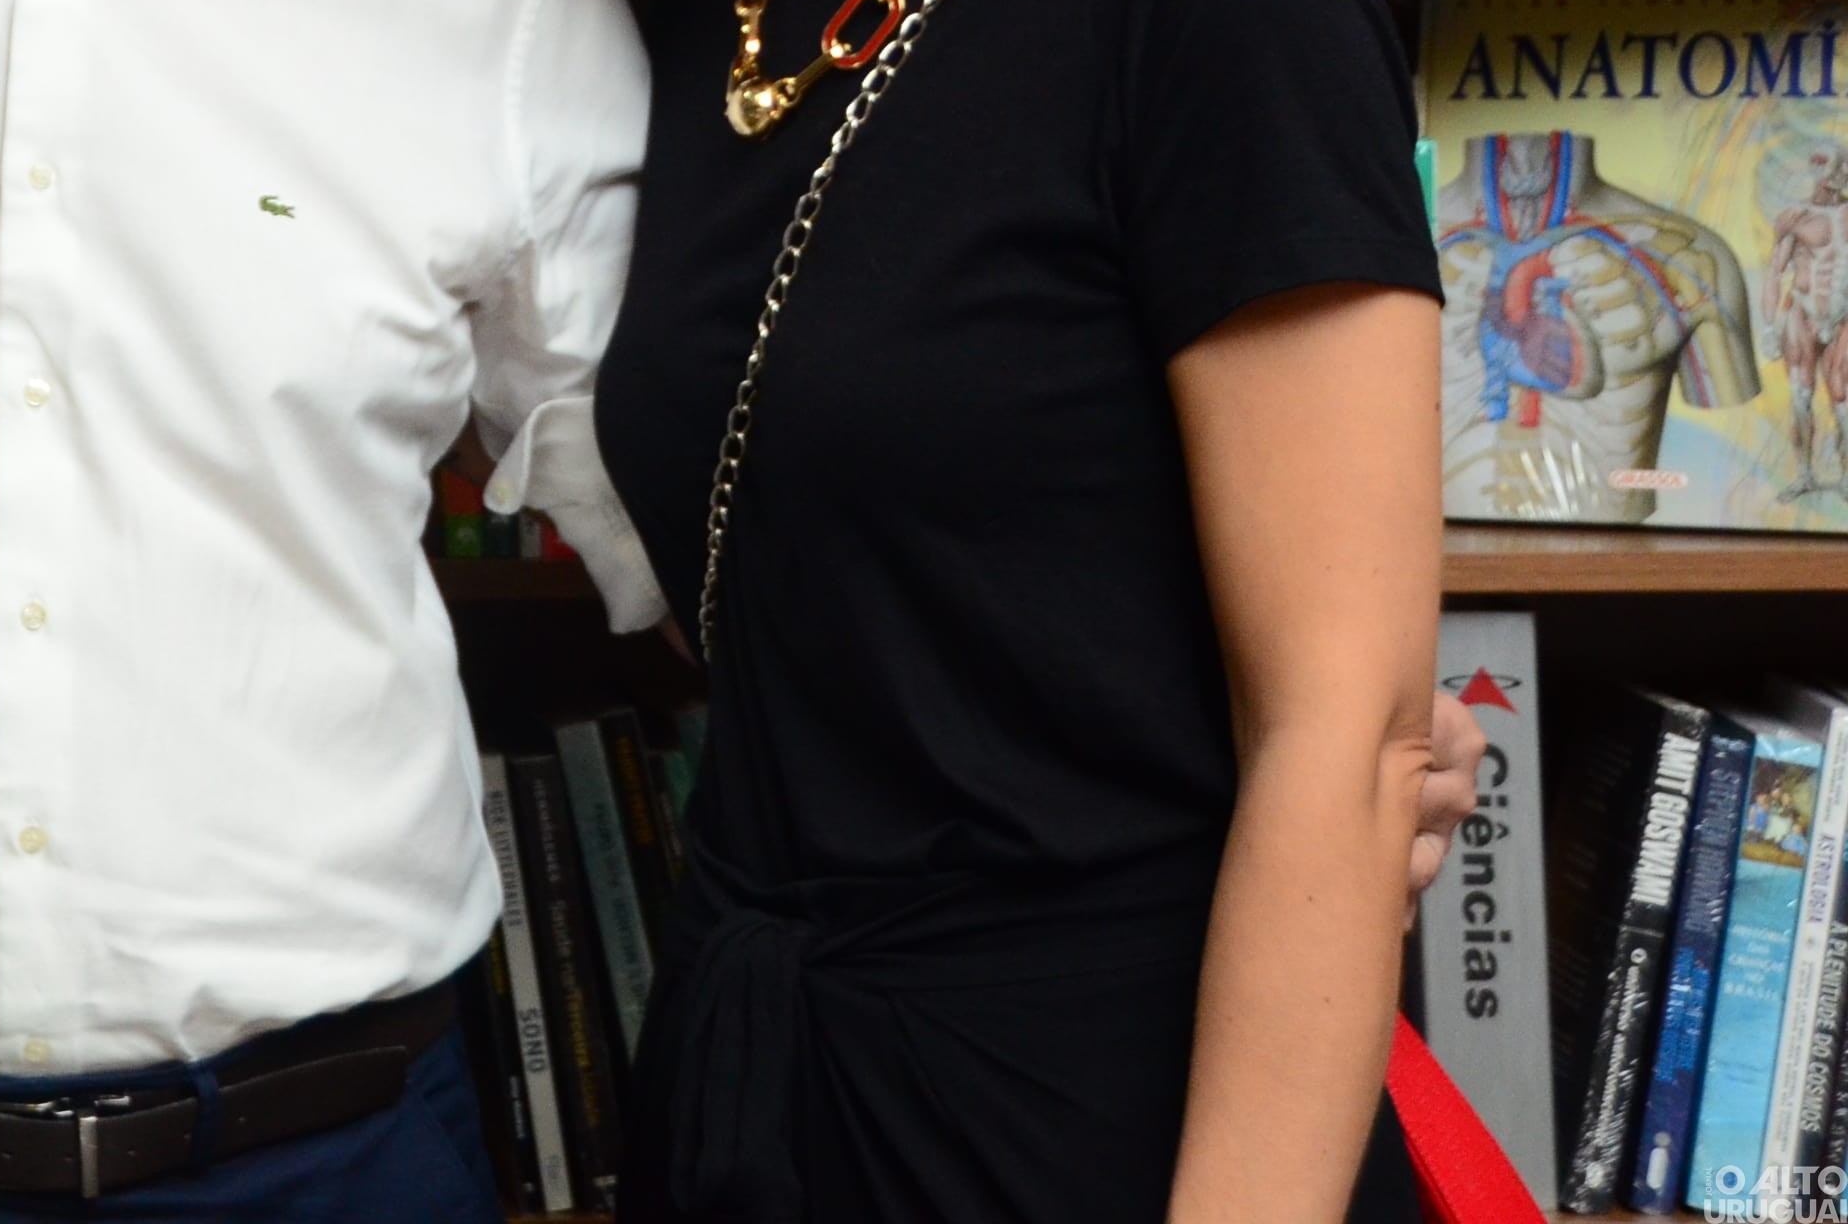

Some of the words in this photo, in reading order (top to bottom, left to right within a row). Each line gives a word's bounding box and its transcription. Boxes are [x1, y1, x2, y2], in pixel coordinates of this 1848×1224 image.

[1450, 19, 1848, 102] ANATOMÍ
[1652, 730, 1702, 798] AMIT
[1450, 740, 1522, 1023] Ciências
[1630, 789, 1691, 908] GOSWAMI
[1804, 832, 1839, 925] ASTROLOGIA
[487, 787, 511, 827] NICK
[516, 1006, 547, 1074] SONO
[548, 897, 581, 958] Saúde
[1814, 936, 1848, 1028] PLENITUDE
[1810, 1031, 1832, 1058] DO
[1798, 1059, 1828, 1132] COSMOS
